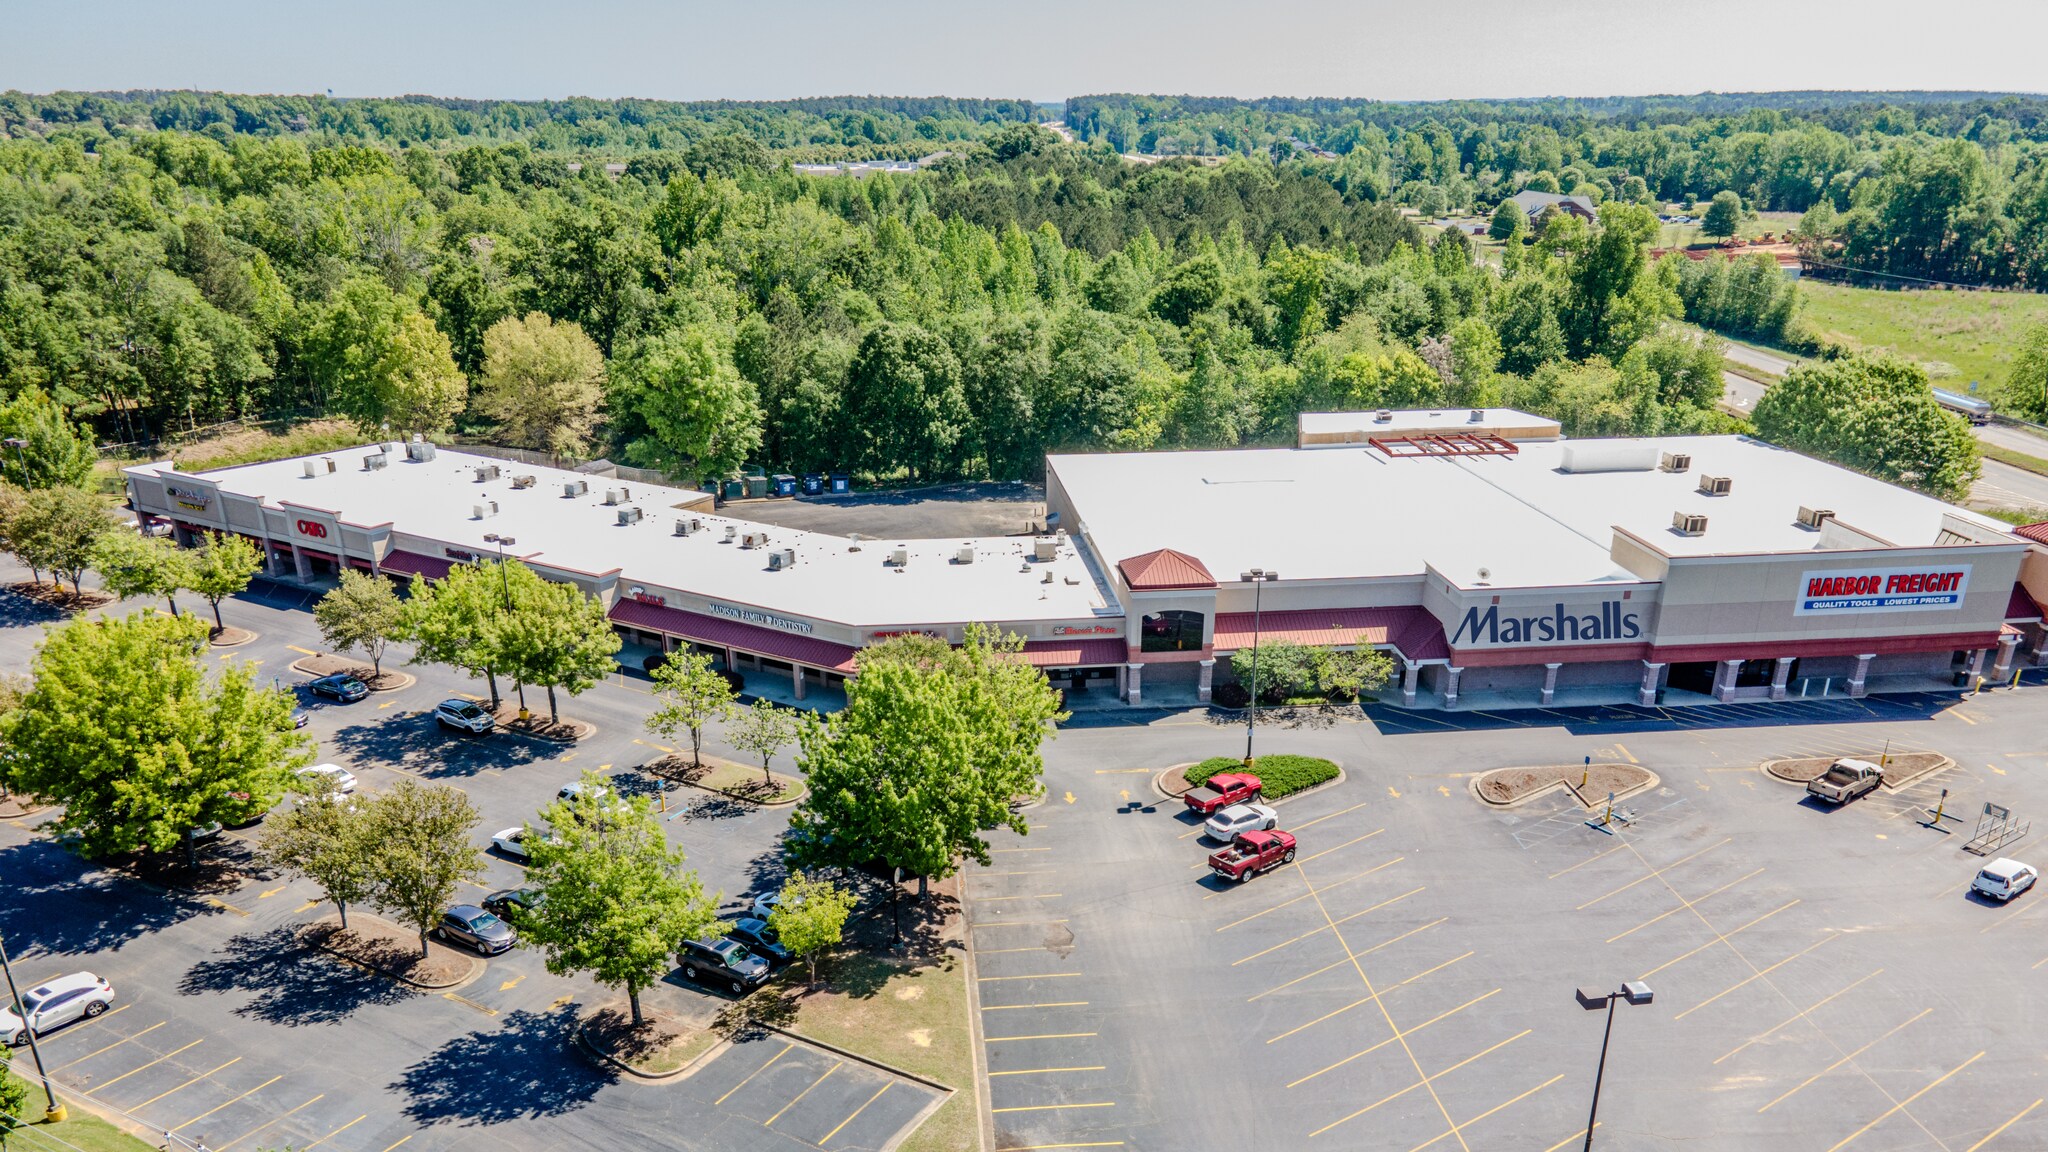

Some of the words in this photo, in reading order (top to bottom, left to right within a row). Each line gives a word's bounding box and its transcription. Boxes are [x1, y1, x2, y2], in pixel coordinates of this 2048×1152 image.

[297, 519, 327, 538] CATO
[1807, 575, 1882, 597] HARBOR
[1885, 572, 1964, 594] FREIGHT
[1812, 600, 1850, 609] QUALITY
[1850, 599, 1878, 607] TOOLS
[1884, 597, 1919, 606] LOWEST
[1919, 596, 1951, 605] PRICES
[709, 604, 740, 618] MADISON
[741, 611, 765, 624] FAMILY
[773, 617, 813, 634] DENTISTRY
[1451, 601, 1640, 644] Marshalls
